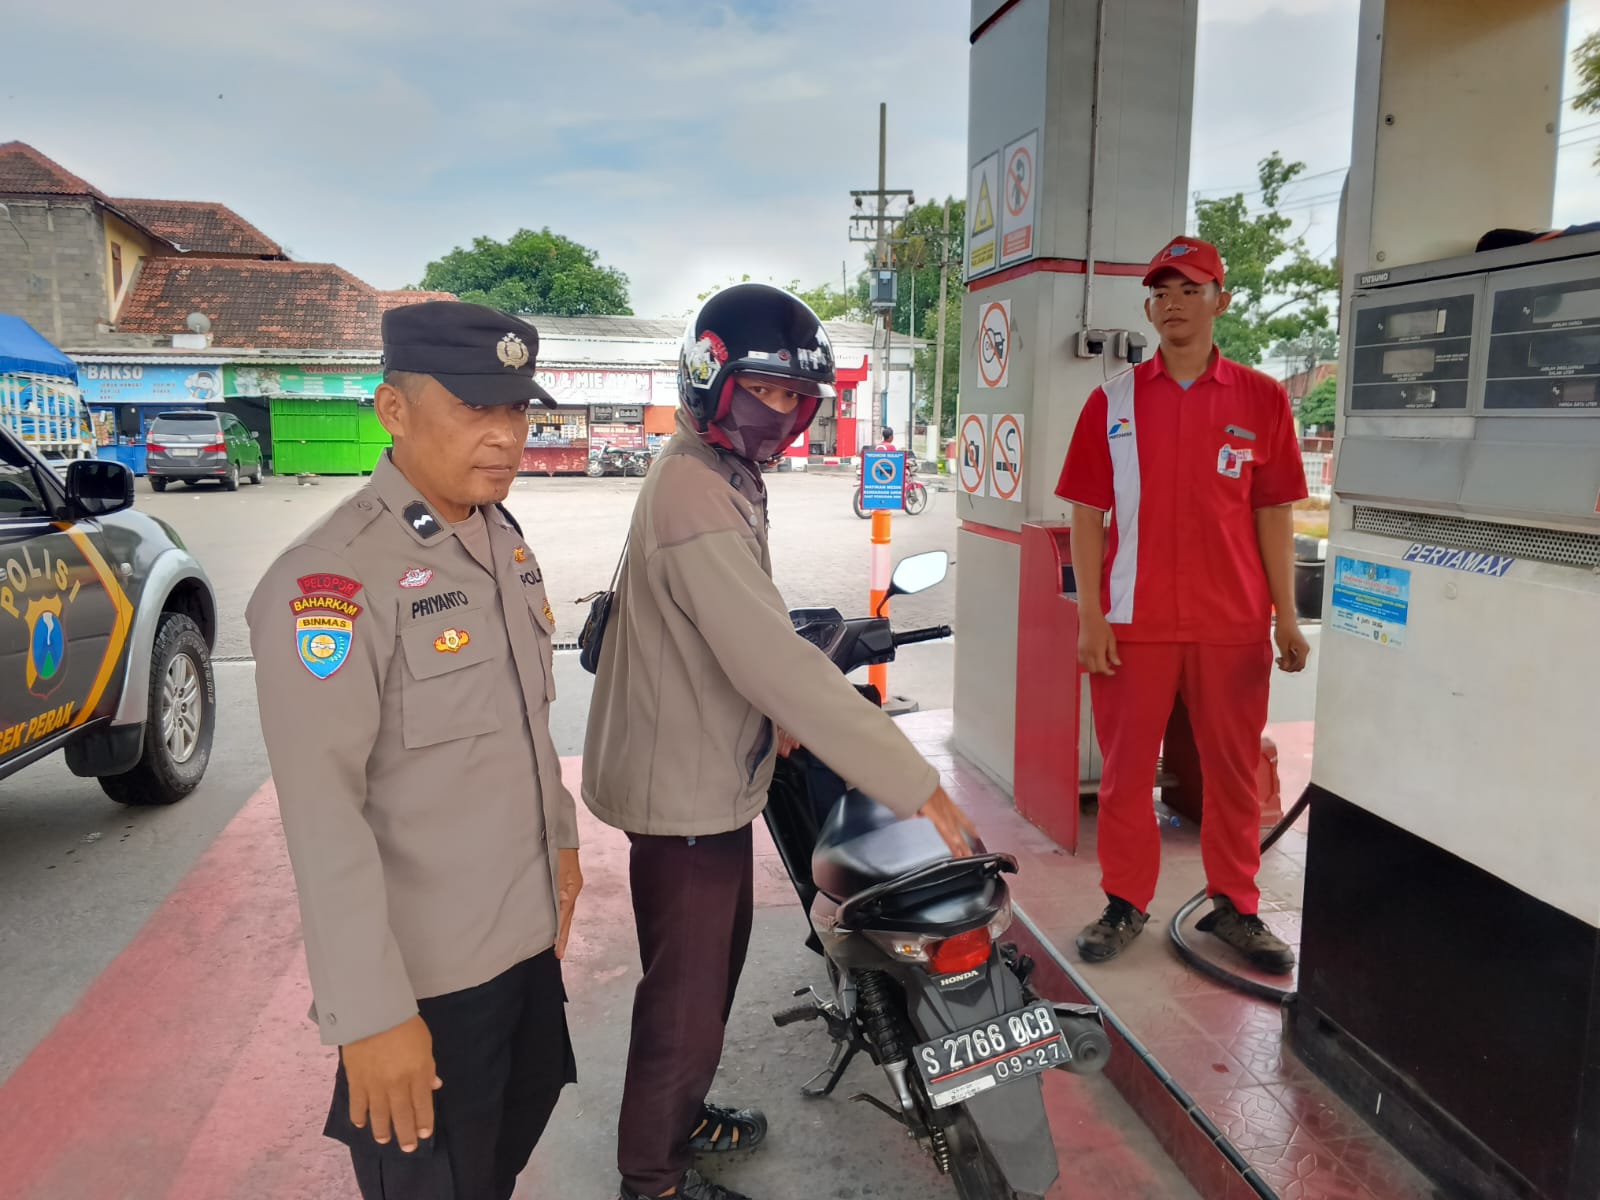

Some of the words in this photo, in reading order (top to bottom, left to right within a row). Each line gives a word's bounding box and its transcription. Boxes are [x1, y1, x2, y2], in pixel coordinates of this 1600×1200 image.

[1362, 273, 1388, 284] TATSUNO
[87, 365, 144, 381] BAKSO
[574, 371, 604, 389] MIE
[1405, 543, 1511, 577] PERTAMAX
[1, 544, 81, 618] POLISI
[303, 576, 355, 593] PELOPOR
[293, 596, 359, 616] BAHARKAM
[411, 590, 469, 619] PRIYANTO
[302, 617, 347, 628] BINMAS
[24, 701, 75, 744] PERAK
[940, 969, 979, 986] HONDA
[922, 1046, 940, 1075] S
[943, 1023, 1006, 1069] 2766
